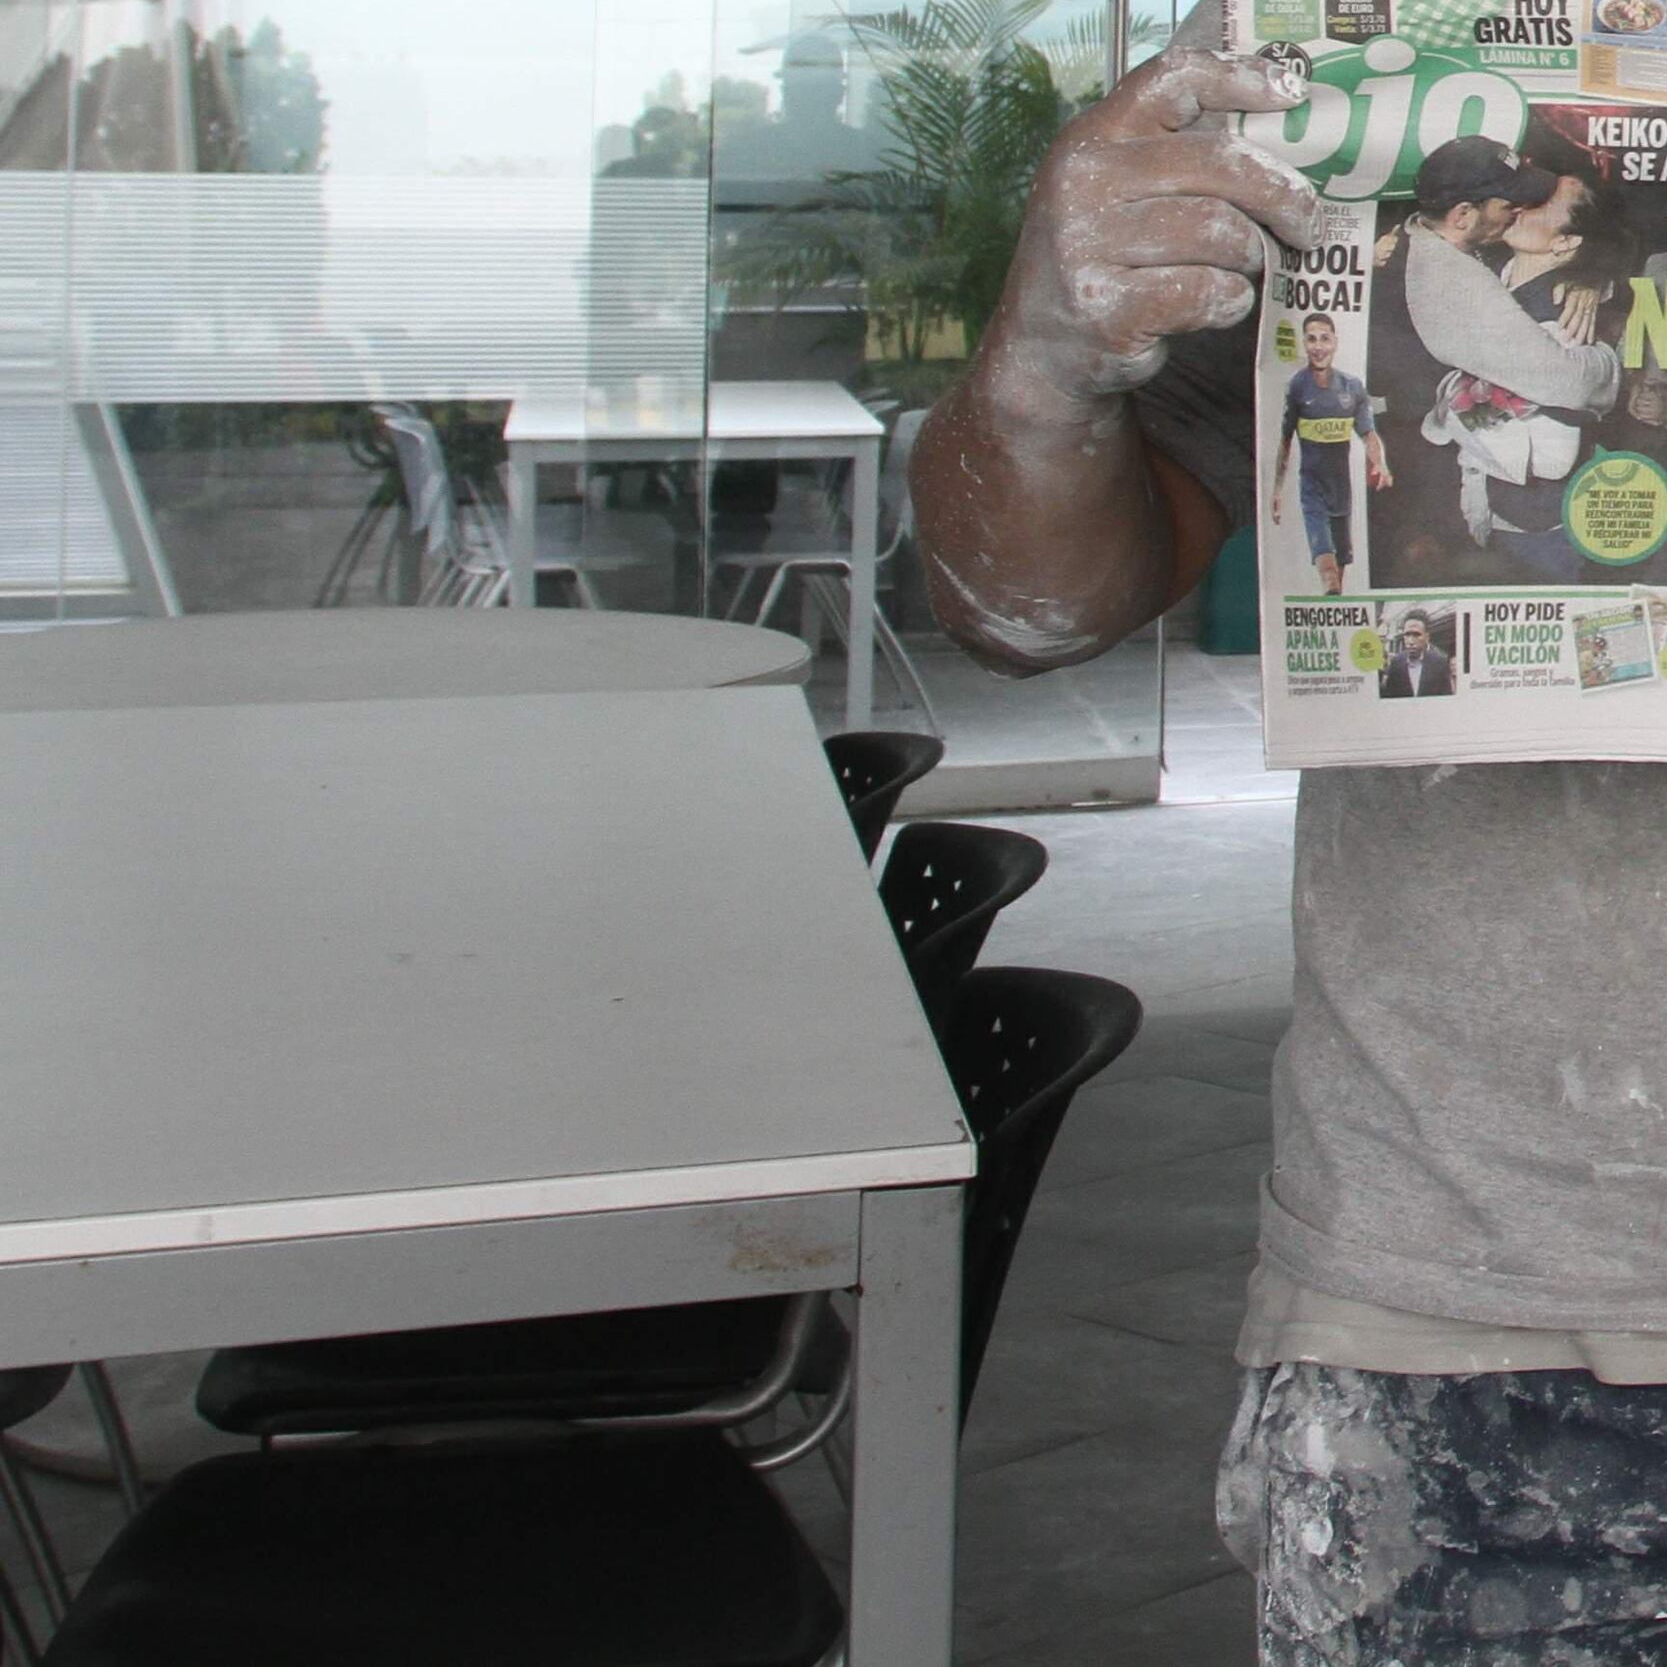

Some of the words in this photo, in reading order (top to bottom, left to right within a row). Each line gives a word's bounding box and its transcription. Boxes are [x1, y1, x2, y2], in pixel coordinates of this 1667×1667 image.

[1474, 17, 1573, 46] GRATIS
[1480, 49, 1536, 64] LÁMINA
[1559, 53, 1569, 65] 6
[1588, 116, 1667, 148] KEIKO
[1622, 152, 1655, 181] SE
[1285, 278, 1362, 312] BOCA!
[1284, 607, 1369, 626] BENGOECHEA
[1484, 604, 1521, 621] HOY
[1526, 603, 1565, 621] PIDE
[1330, 631, 1339, 649] A
[1485, 626, 1506, 643] EN
[1511, 624, 1563, 643] MODO
[1486, 638, 1560, 664] VACILÓN
[1287, 652, 1340, 672] GALLESE
